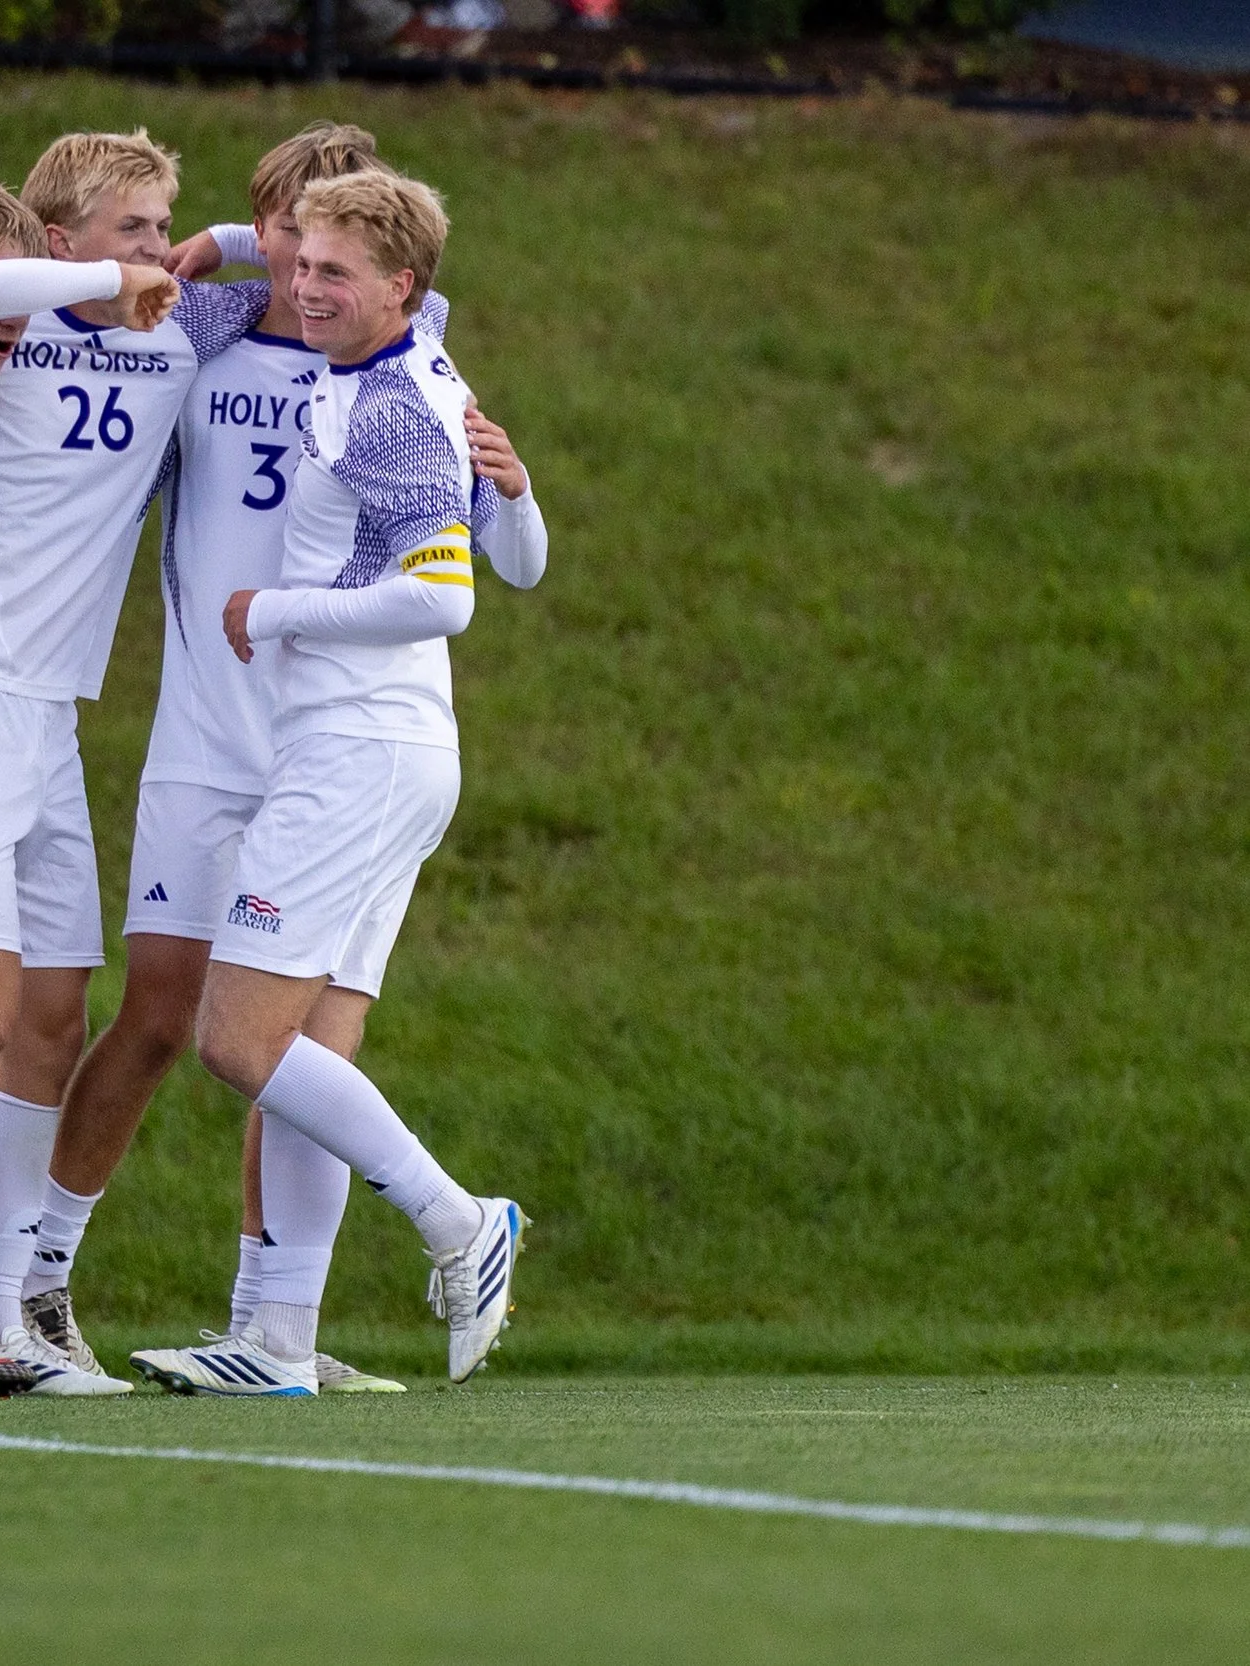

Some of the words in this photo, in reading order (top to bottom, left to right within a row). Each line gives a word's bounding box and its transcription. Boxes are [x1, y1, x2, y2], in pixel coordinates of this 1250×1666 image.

[11, 341, 81, 370] HOLY
[58, 385, 134, 452] 26
[209, 391, 289, 430] HOLY
[241, 442, 290, 511] 3
[402, 548, 456, 573] APTAIN
[227, 914, 281, 935] LEAGUE
[230, 907, 284, 927] PATRIOT
